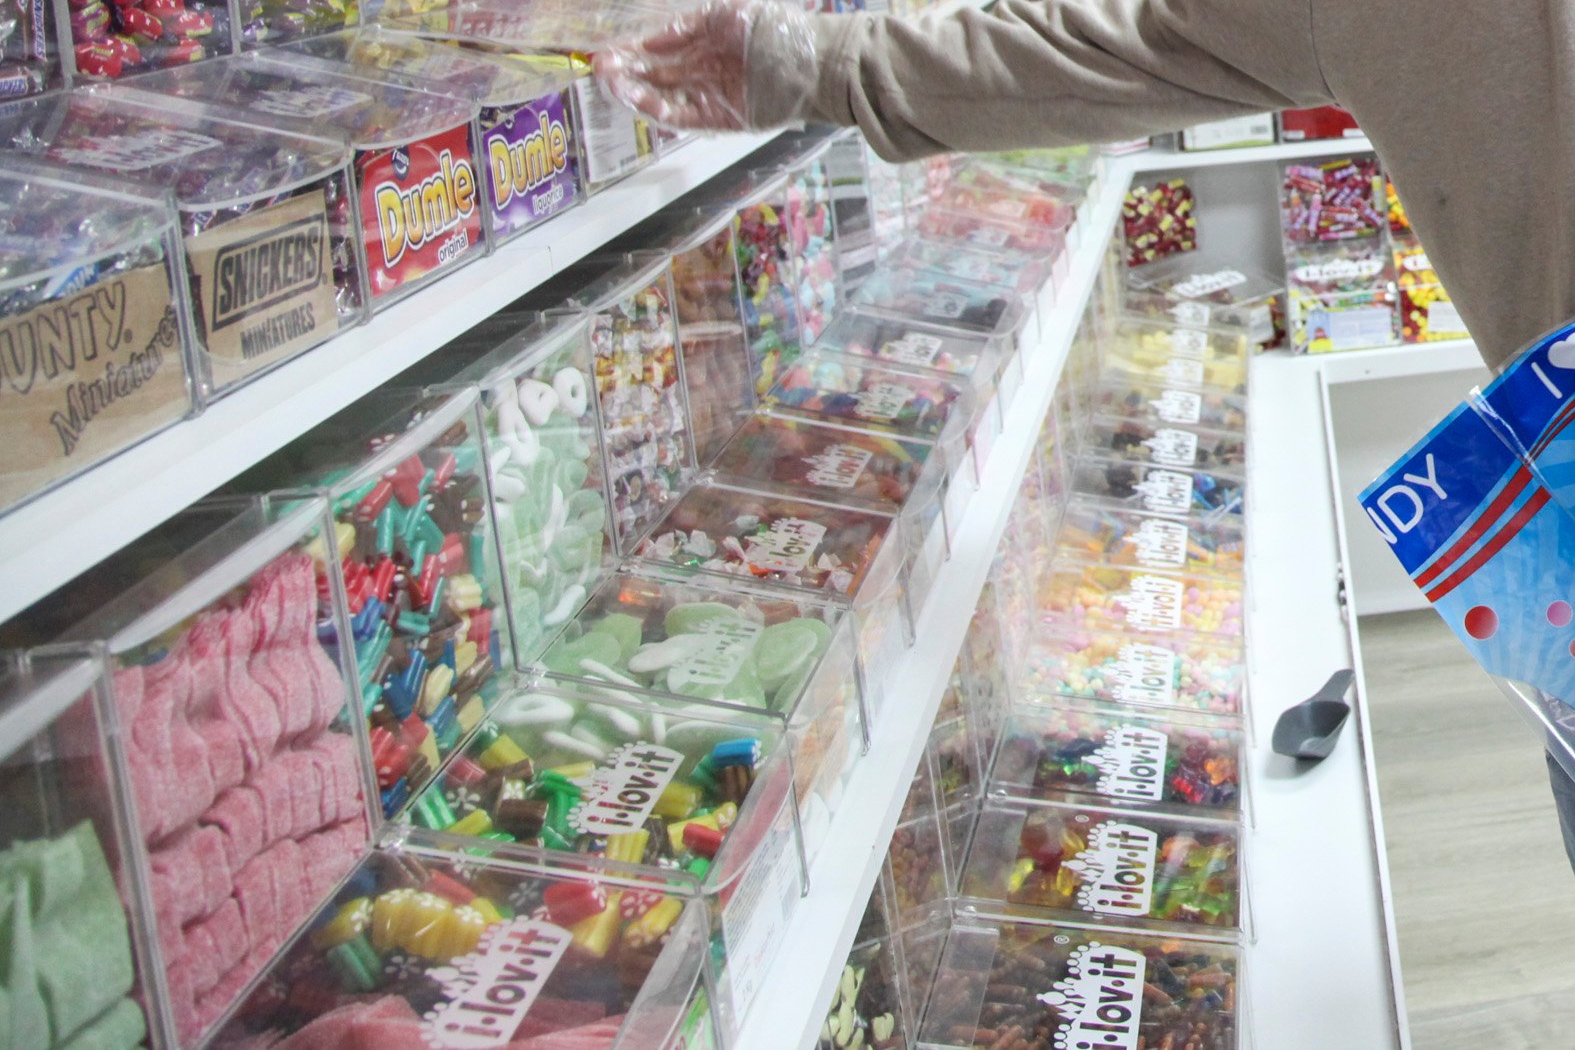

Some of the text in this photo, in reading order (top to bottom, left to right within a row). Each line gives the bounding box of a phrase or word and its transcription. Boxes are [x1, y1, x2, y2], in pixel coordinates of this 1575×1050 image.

[488, 110, 567, 210] Dumle
[533, 184, 564, 215] liquorice
[376, 150, 475, 267] Dumle
[439, 229, 468, 262] original
[219, 226, 319, 315] SNICKERS
